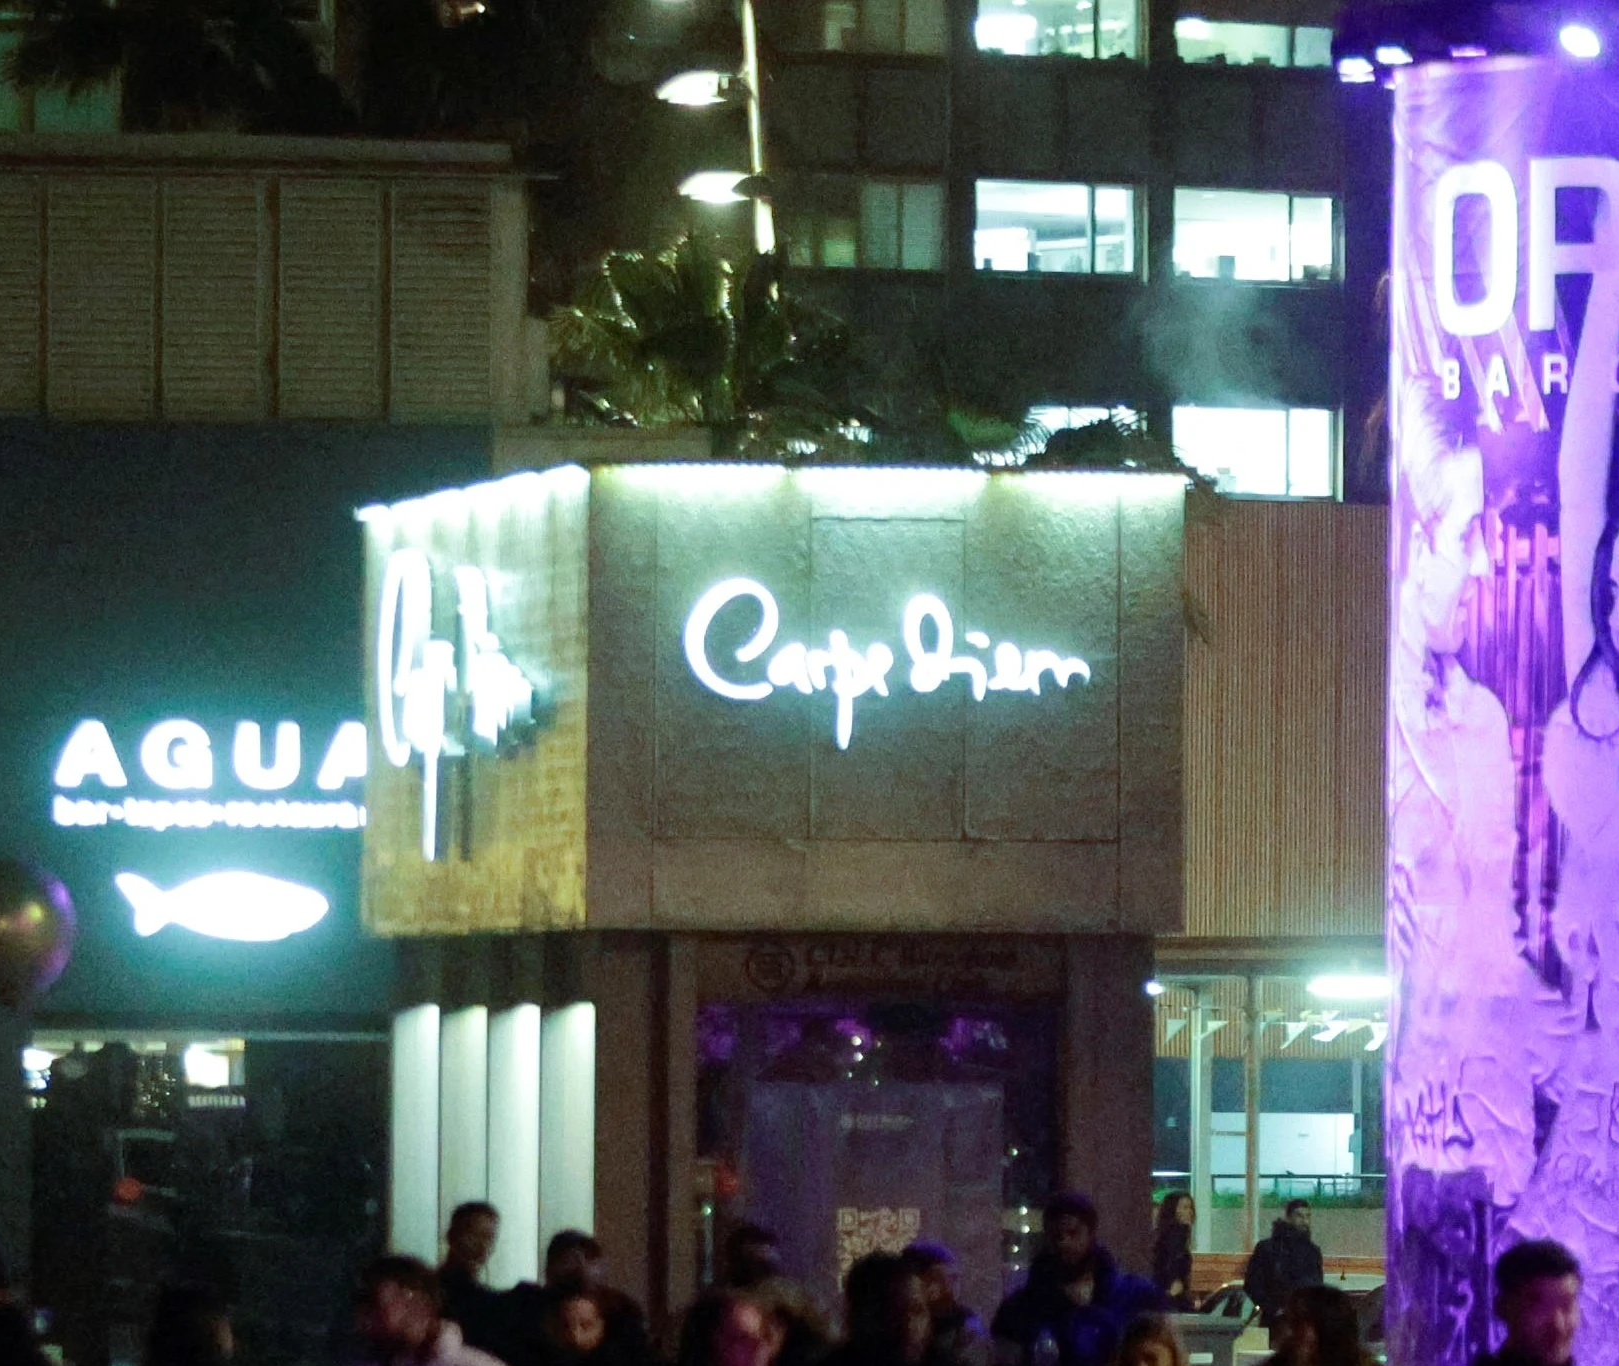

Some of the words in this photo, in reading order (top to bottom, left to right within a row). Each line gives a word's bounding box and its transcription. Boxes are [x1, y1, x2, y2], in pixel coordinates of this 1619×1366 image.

[684, 577, 894, 751] Carpe
[903, 593, 1091, 702] Diem
[54, 718, 367, 790] AGUA
